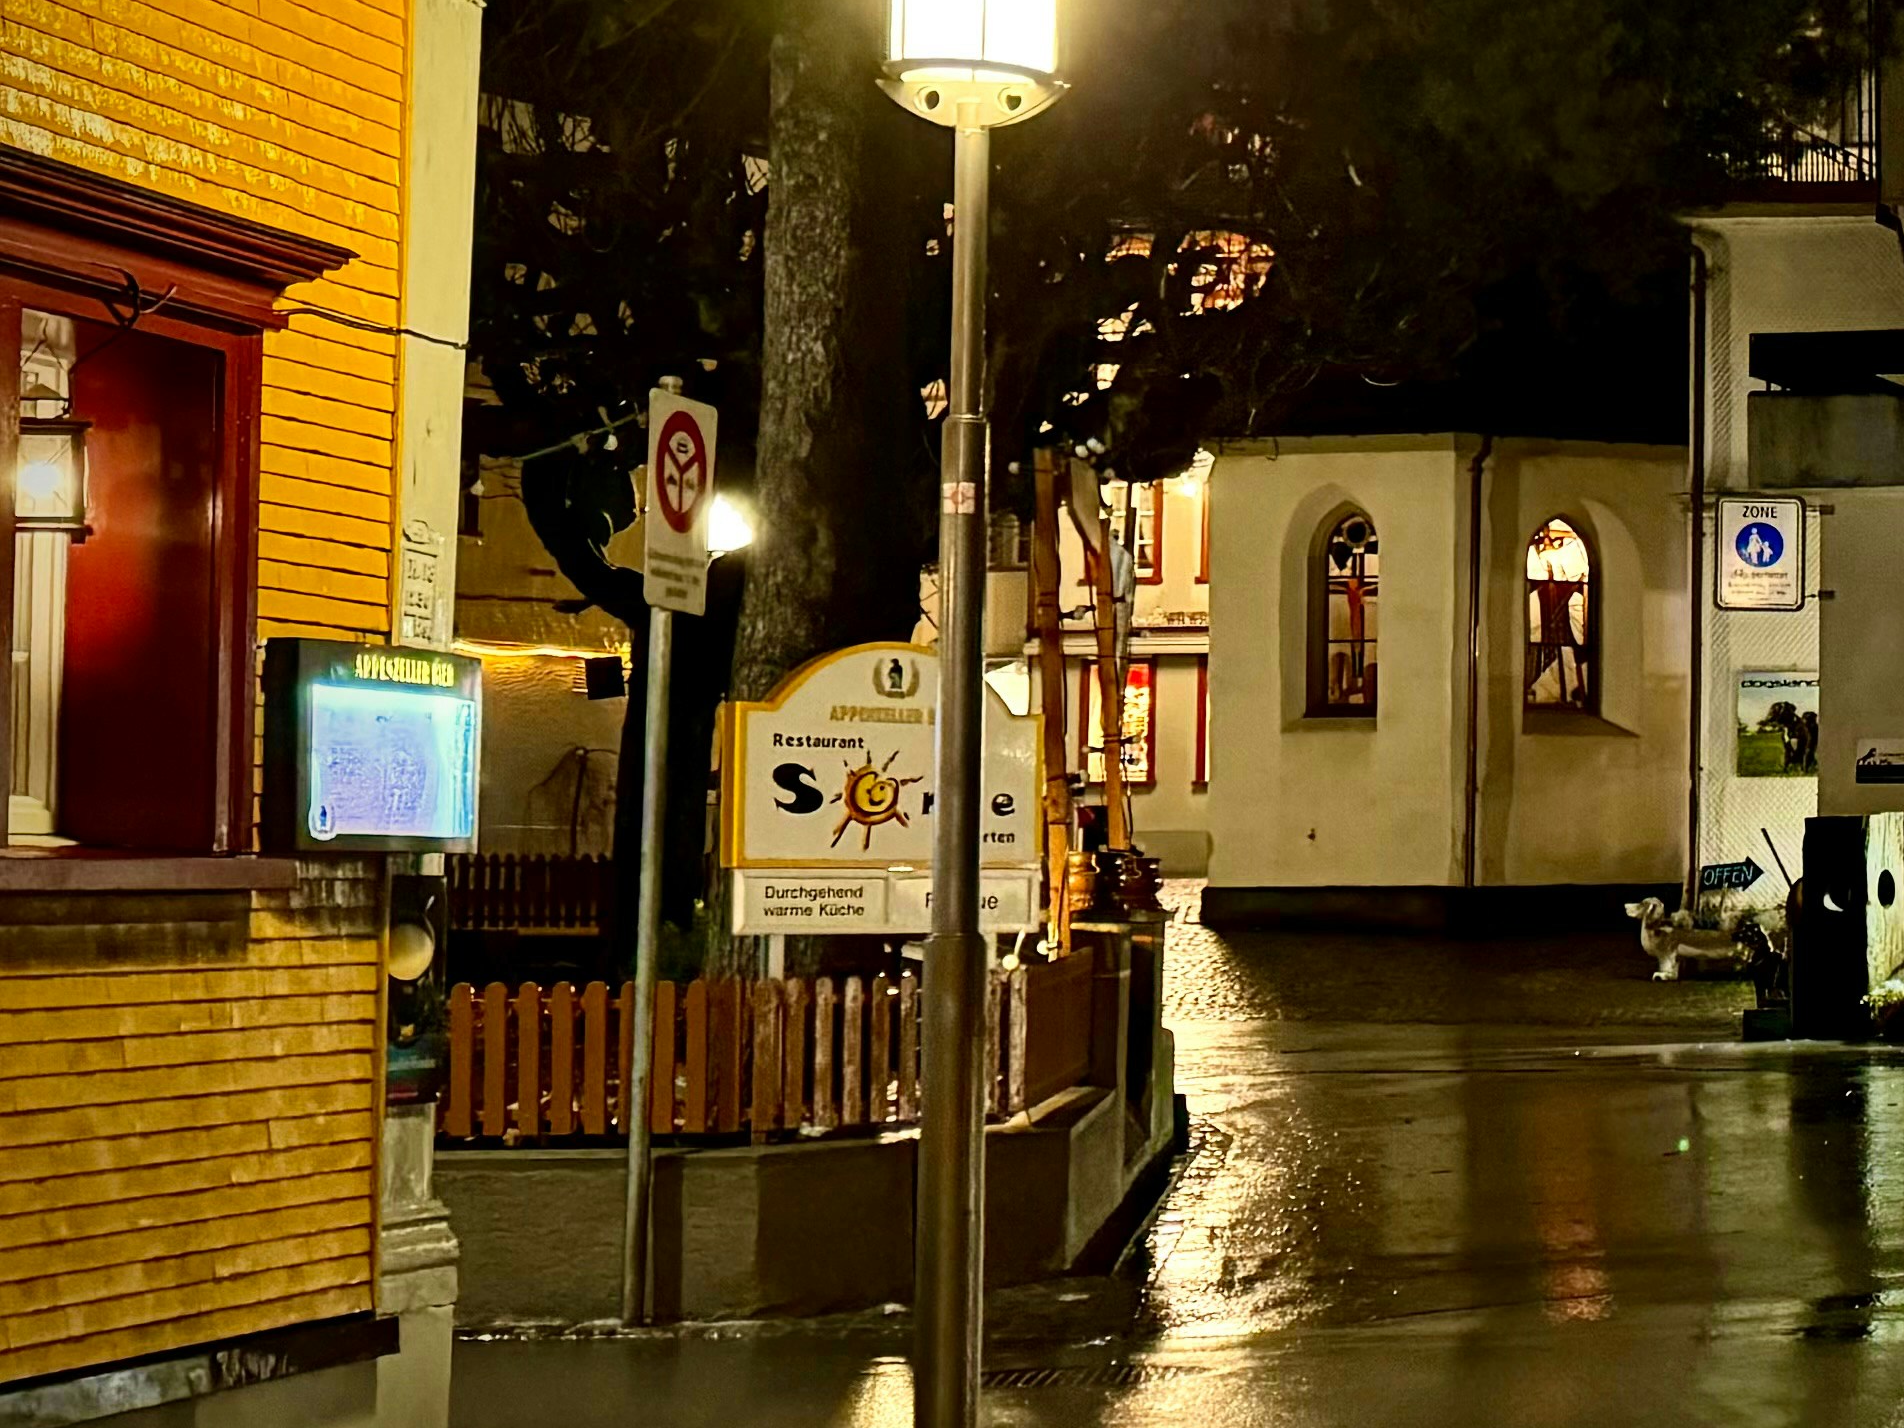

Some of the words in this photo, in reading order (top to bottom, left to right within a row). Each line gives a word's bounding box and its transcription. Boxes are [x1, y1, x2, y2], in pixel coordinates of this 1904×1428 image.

[1742, 506, 1778, 518] ZONE
[773, 733, 864, 749] Restaurant
[1703, 865, 1754, 886] OFFEN
[764, 885, 864, 900] Durchgehend
[763, 906, 813, 917] warme
[819, 903, 865, 917] Küche
